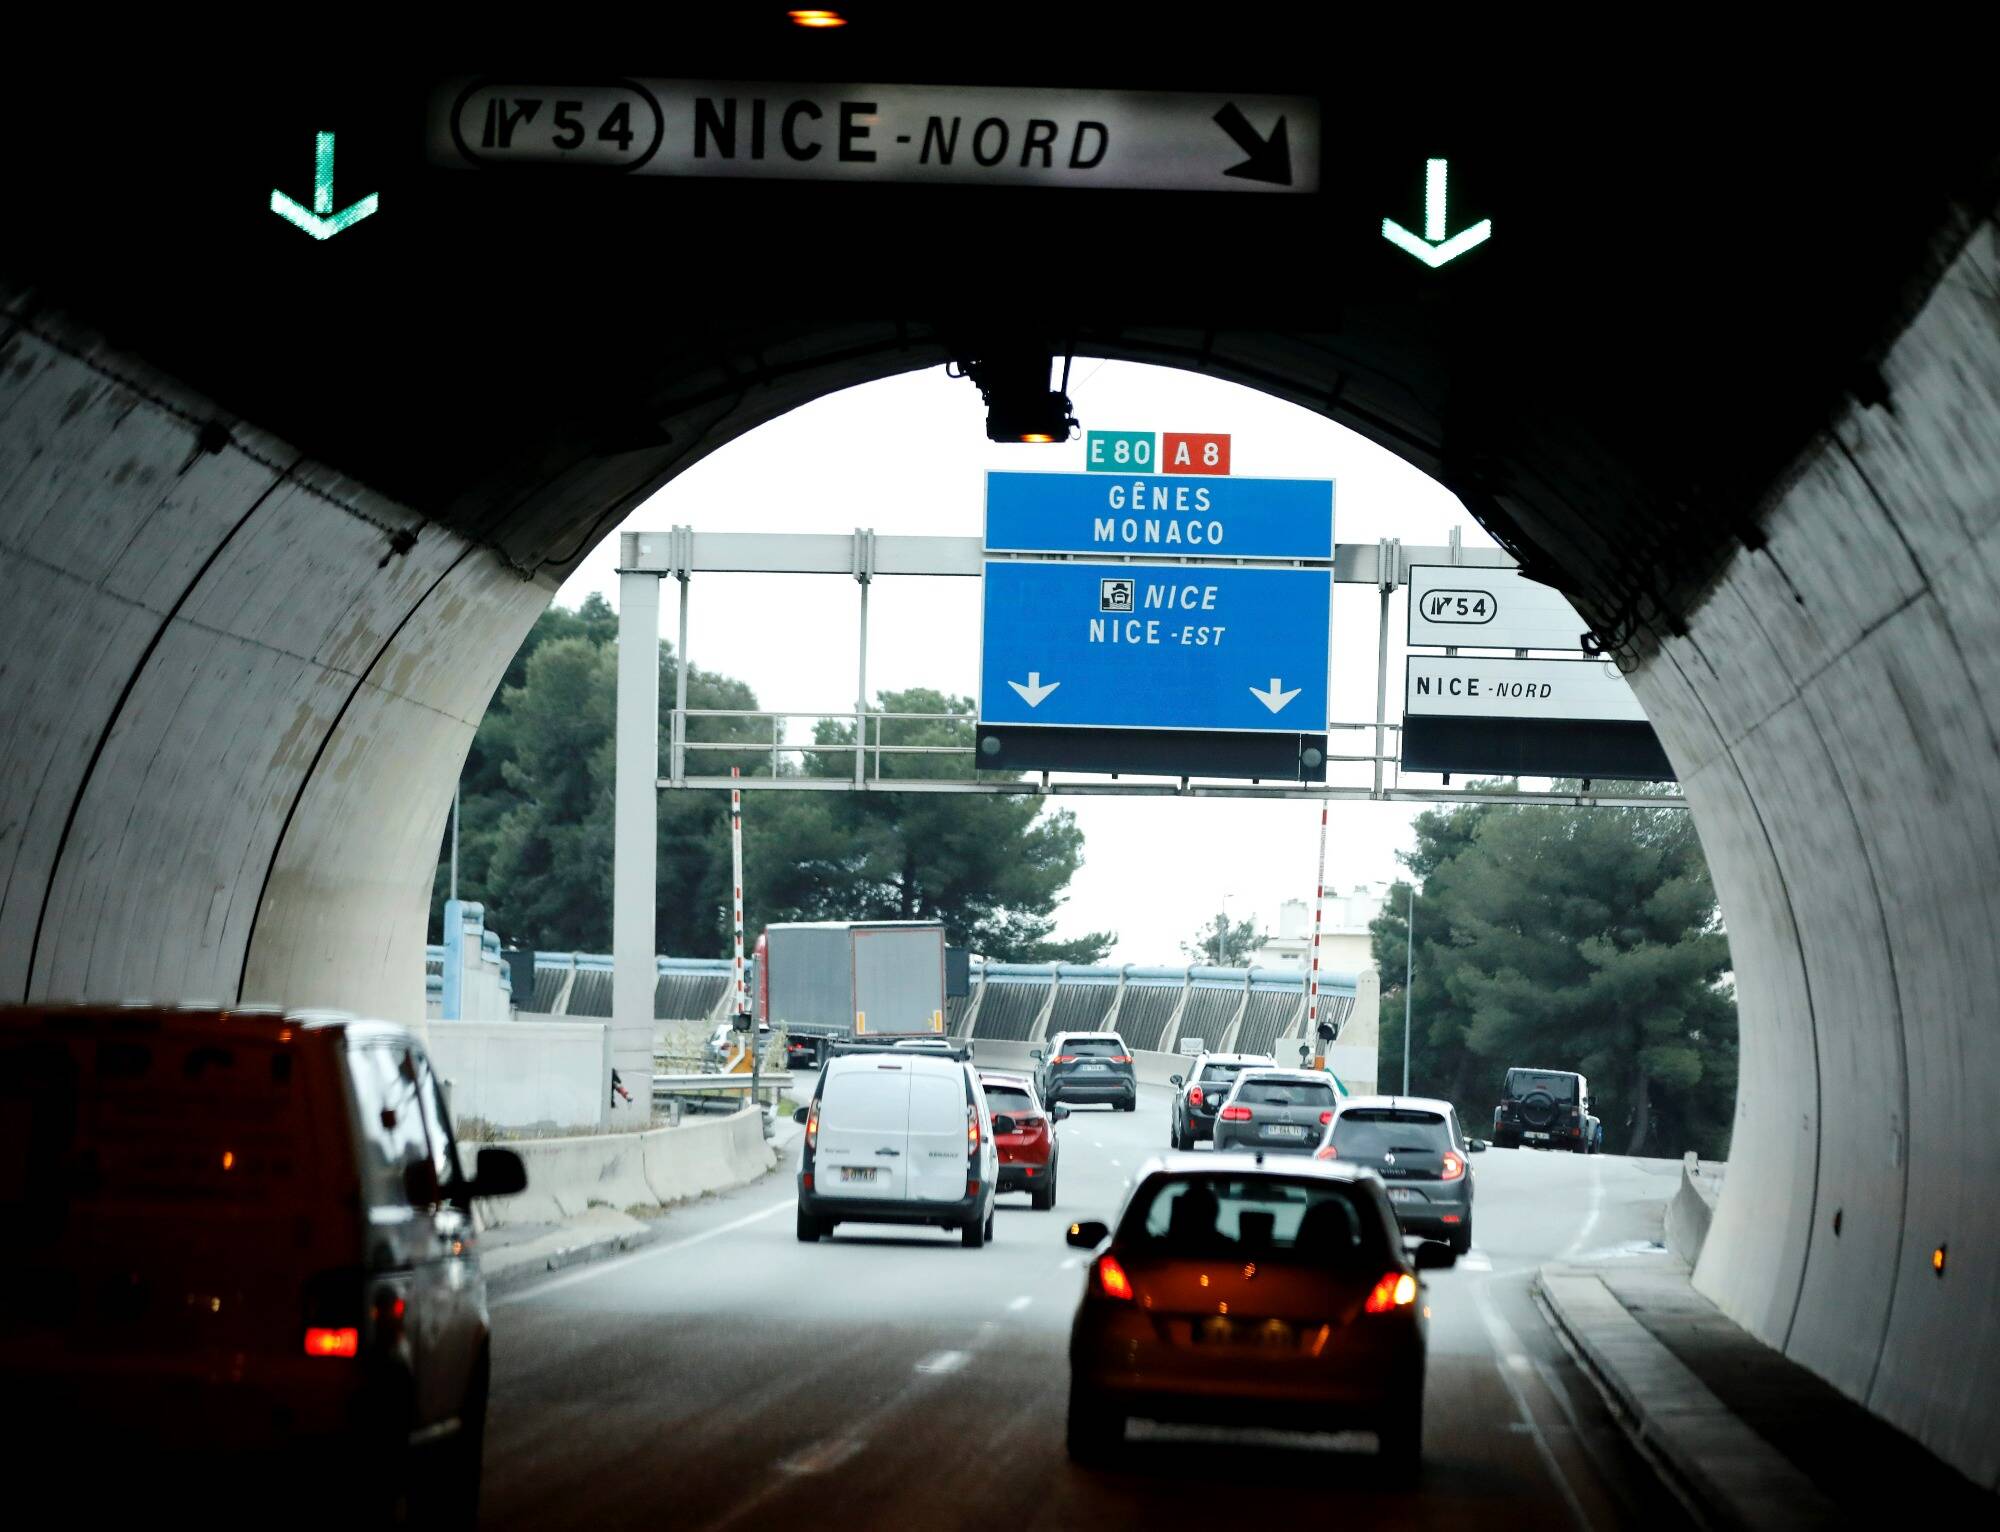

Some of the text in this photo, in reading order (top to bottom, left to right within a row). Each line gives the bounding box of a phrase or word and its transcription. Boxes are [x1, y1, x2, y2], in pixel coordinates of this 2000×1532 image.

[552, 100, 634, 151] 54
[1091, 439, 1151, 464] E 80
[1174, 441, 1219, 466] A 8
[1109, 481, 1211, 512] GÊNES
[1094, 518, 1224, 545] MONACO
[1144, 584, 1218, 610] NICE
[1456, 597, 1487, 617] 54
